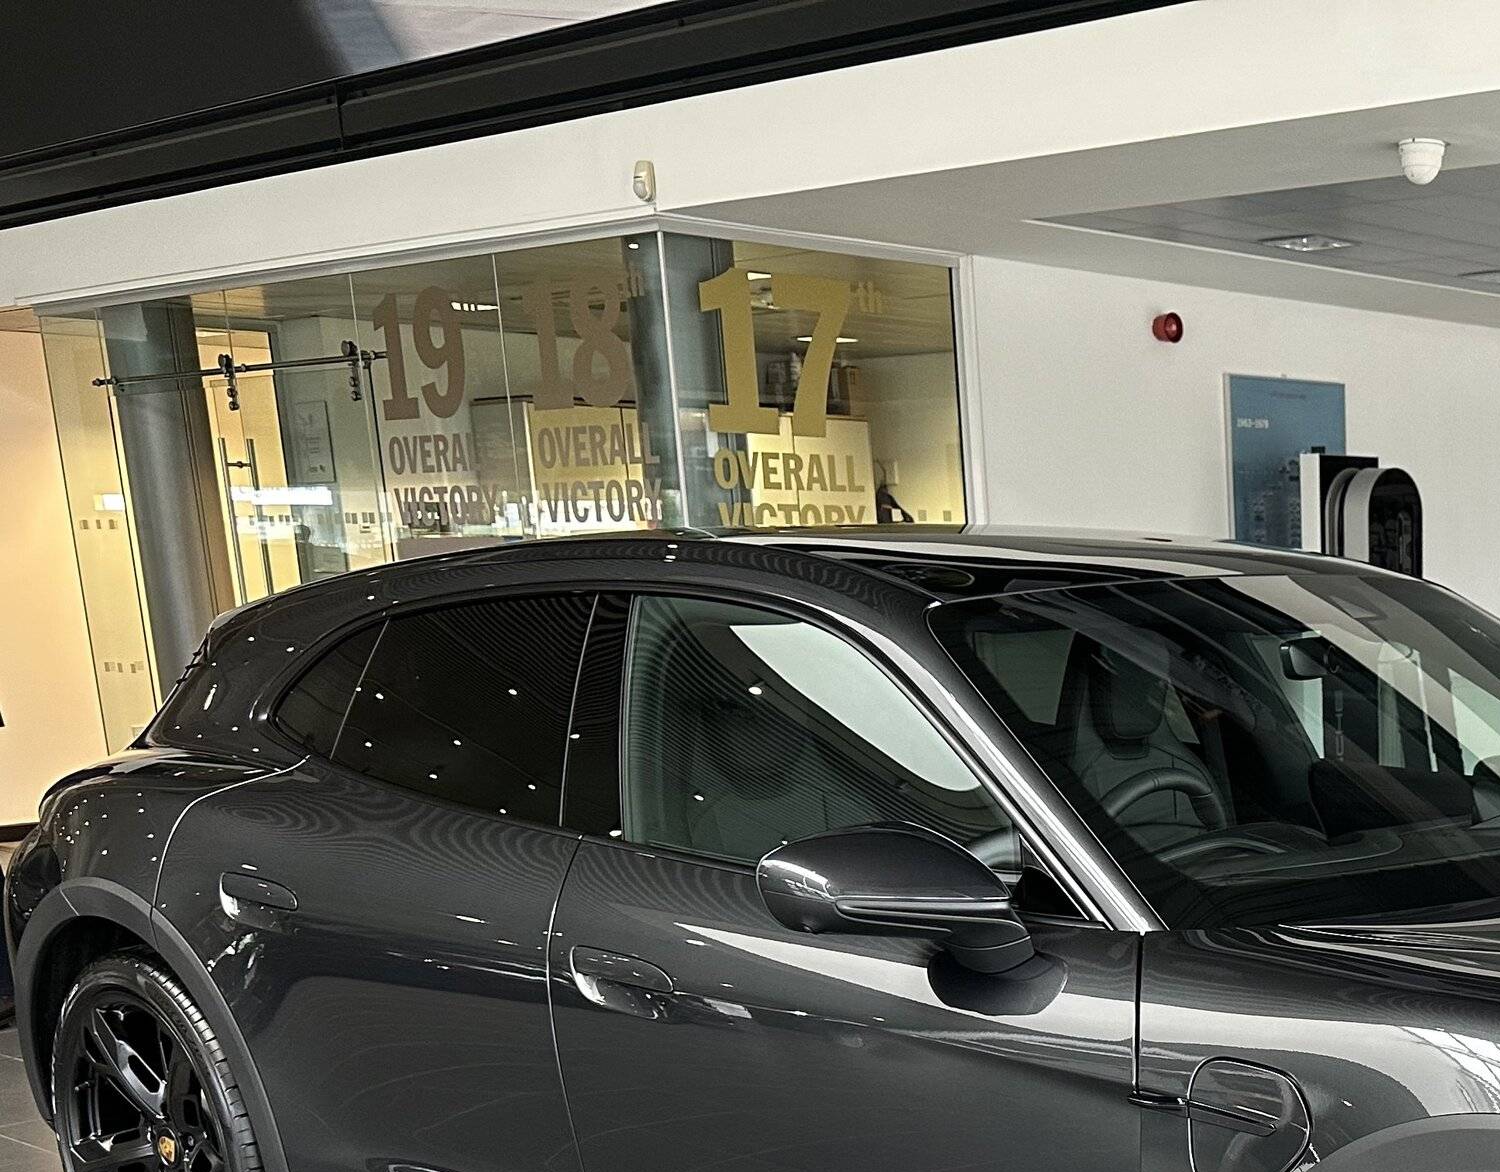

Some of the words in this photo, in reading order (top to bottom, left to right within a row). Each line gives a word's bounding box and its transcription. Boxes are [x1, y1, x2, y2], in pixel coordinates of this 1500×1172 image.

[538, 422, 661, 469] OVERALL
[713, 448, 866, 492] OVERALL
[394, 484, 500, 527] VICTORY
[542, 478, 662, 523] VICTORY
